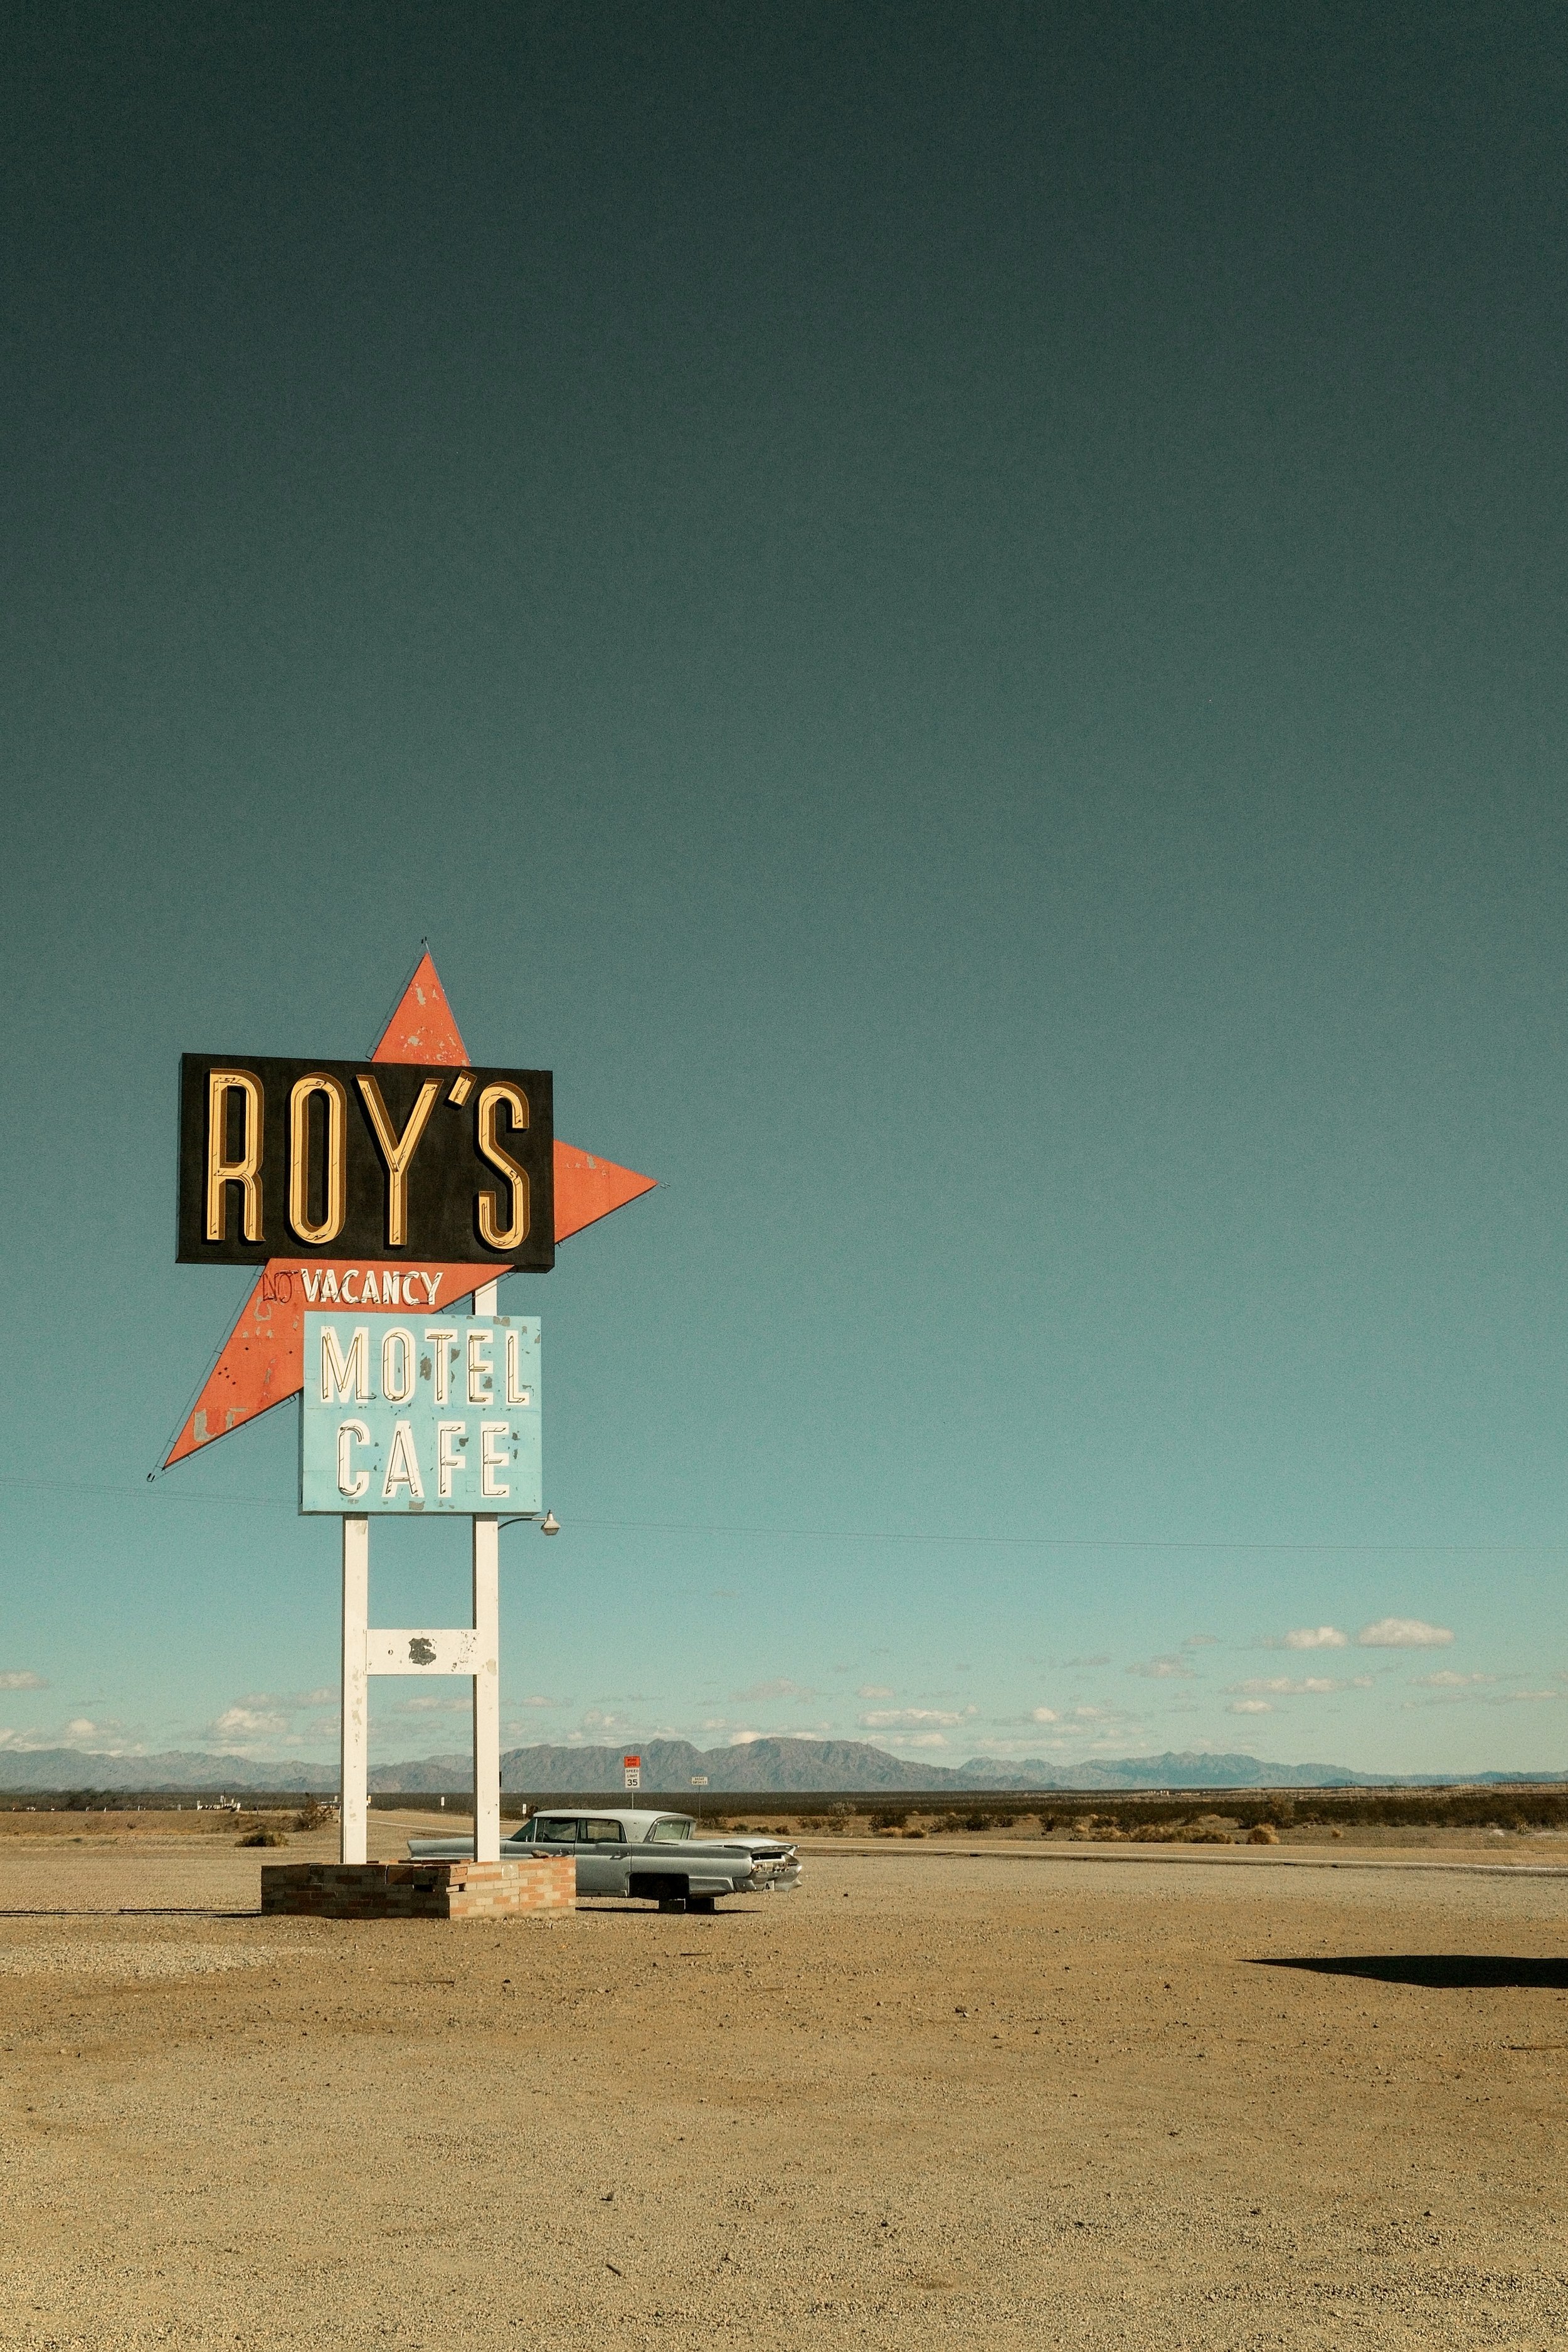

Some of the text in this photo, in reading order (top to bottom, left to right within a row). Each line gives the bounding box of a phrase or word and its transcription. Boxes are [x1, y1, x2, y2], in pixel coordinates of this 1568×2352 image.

[206, 1068, 531, 1249] ROY'S
[300, 1268, 443, 1306] VACANCY
[320, 1326, 529, 1406] MOTEL
[337, 1419, 510, 1498] CAFE
